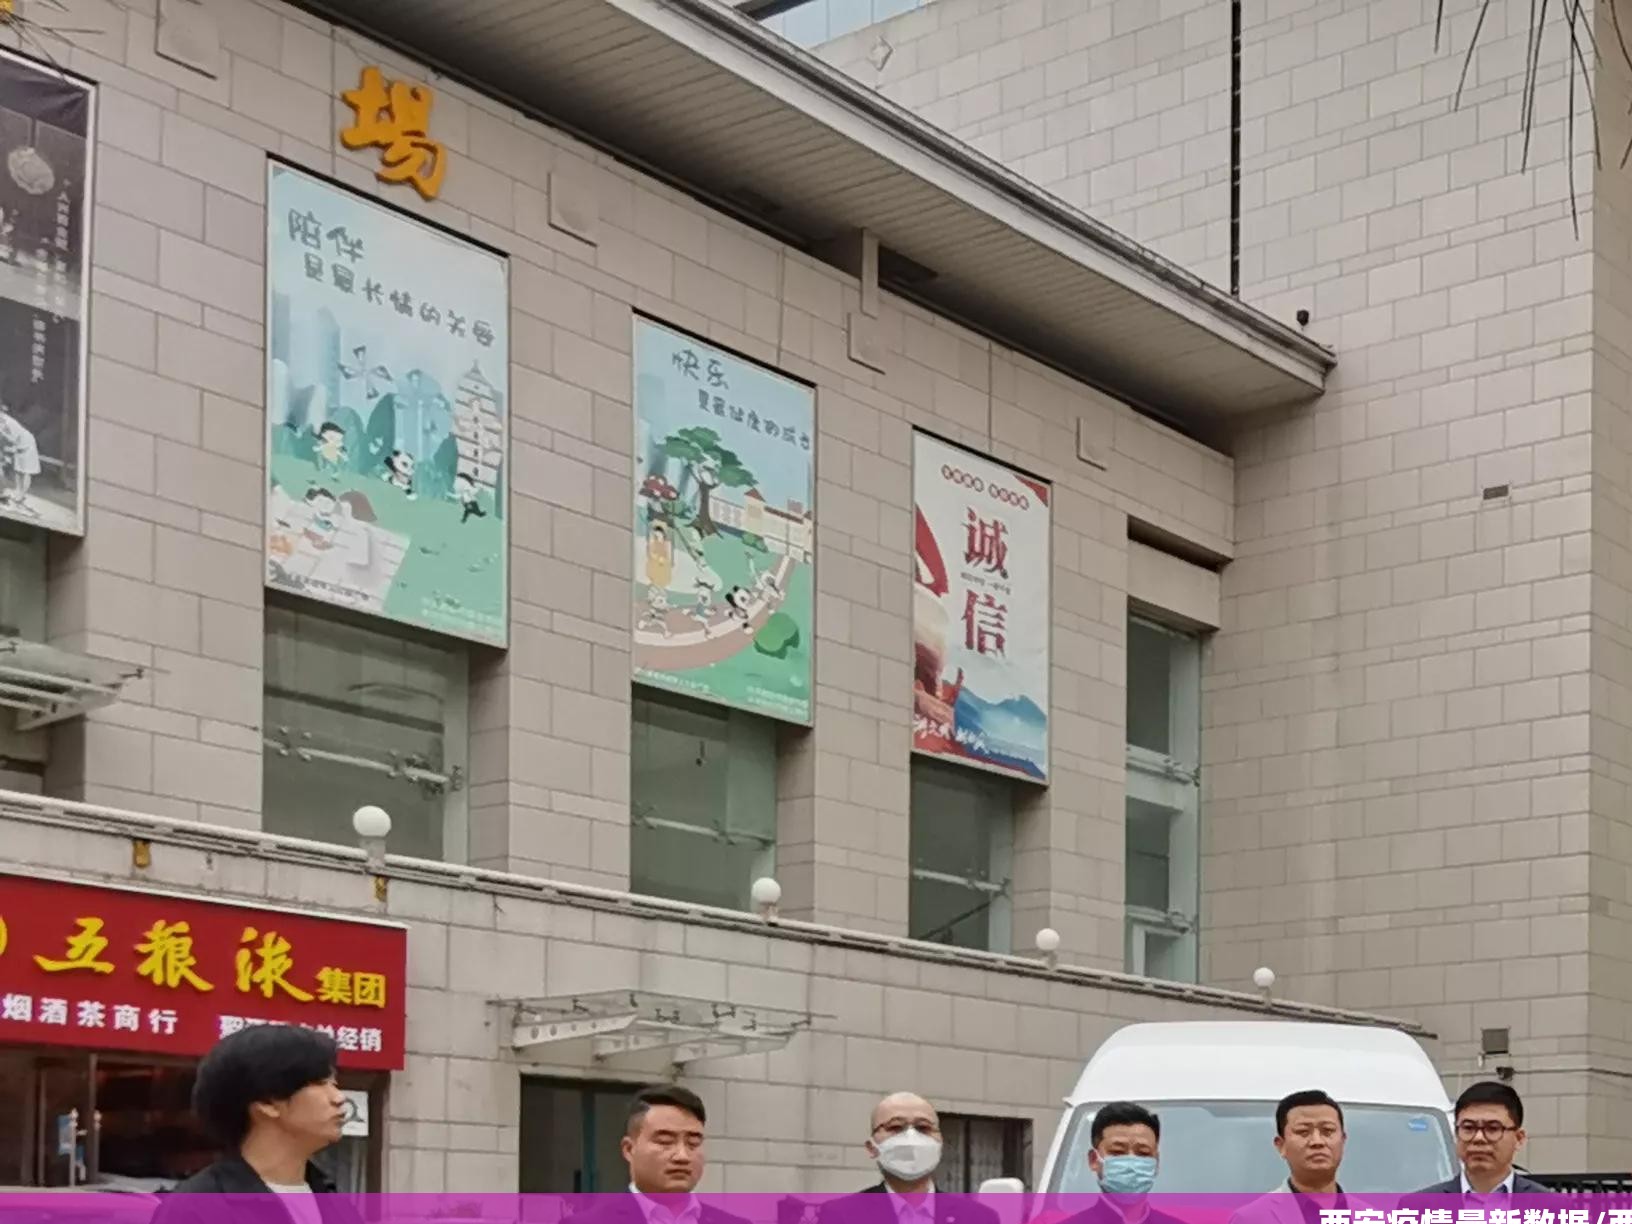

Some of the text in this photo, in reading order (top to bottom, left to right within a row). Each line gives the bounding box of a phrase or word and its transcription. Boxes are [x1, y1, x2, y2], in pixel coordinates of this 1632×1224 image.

[288, 208, 364, 263] 陪伴
[672, 349, 729, 389] 快乐
[961, 506, 1009, 658] 诚信
[2, 993, 178, 1035] 烟酒茶商行
